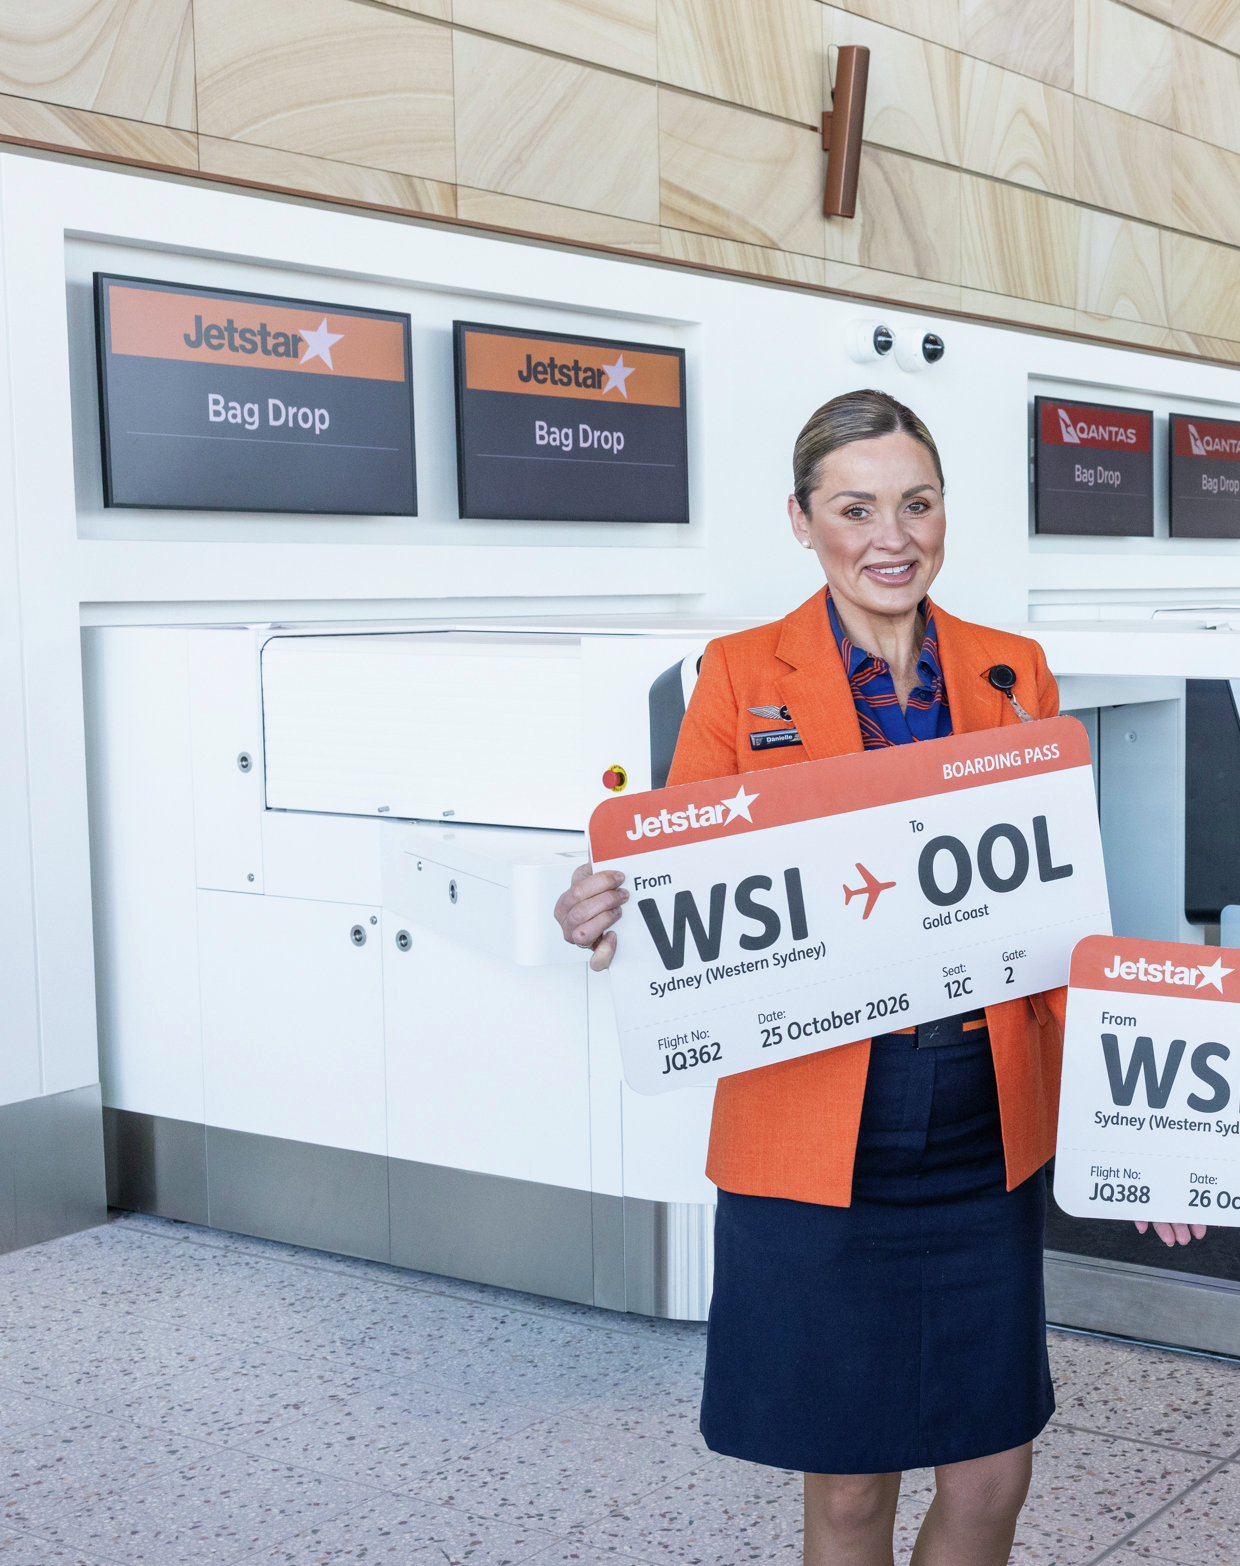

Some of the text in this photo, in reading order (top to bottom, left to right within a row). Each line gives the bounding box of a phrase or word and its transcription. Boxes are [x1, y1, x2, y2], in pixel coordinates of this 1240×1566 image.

[183, 314, 301, 360] Jetstar
[518, 353, 606, 390] Jetstar
[208, 393, 330, 434] Bag Drop
[534, 420, 625, 455] Bag Drop
[1076, 422, 1136, 444] QANTAS
[1075, 465, 1121, 487] Bag Drop
[1202, 475, 1240, 495] Bag Drop
[766, 735, 793, 743] Danielle
[942, 743, 1060, 780] BOARDING PASS
[626, 802, 726, 841] Jetstar
[908, 819, 924, 833] To
[917, 815, 1074, 907] OOL
[633, 874, 672, 891] From
[637, 867, 809, 971] WSI
[922, 904, 990, 930] Gold Coast
[1001, 949, 1027, 962] Gate:
[649, 941, 826, 998] Sydney (Western Sydney)
[942, 963, 967, 978] Seat:
[1004, 966, 1015, 985] 2
[1104, 955, 1201, 987] Jetstar
[944, 976, 973, 1000] 12C
[757, 1010, 787, 1025] Date:
[760, 993, 910, 1049] 25 October 2026
[1101, 1011, 1137, 1027] From
[657, 1029, 710, 1051] Flight No:
[662, 1041, 723, 1075] JQ362
[1094, 1110, 1146, 1131] Sydney
[1148, 1114, 1212, 1133] (Western
[1090, 1165, 1141, 1181] Flight No:
[1189, 1172, 1218, 1185] Date:
[1088, 1182, 1150, 1204] JQ388
[1188, 1188, 1212, 1208] 26
